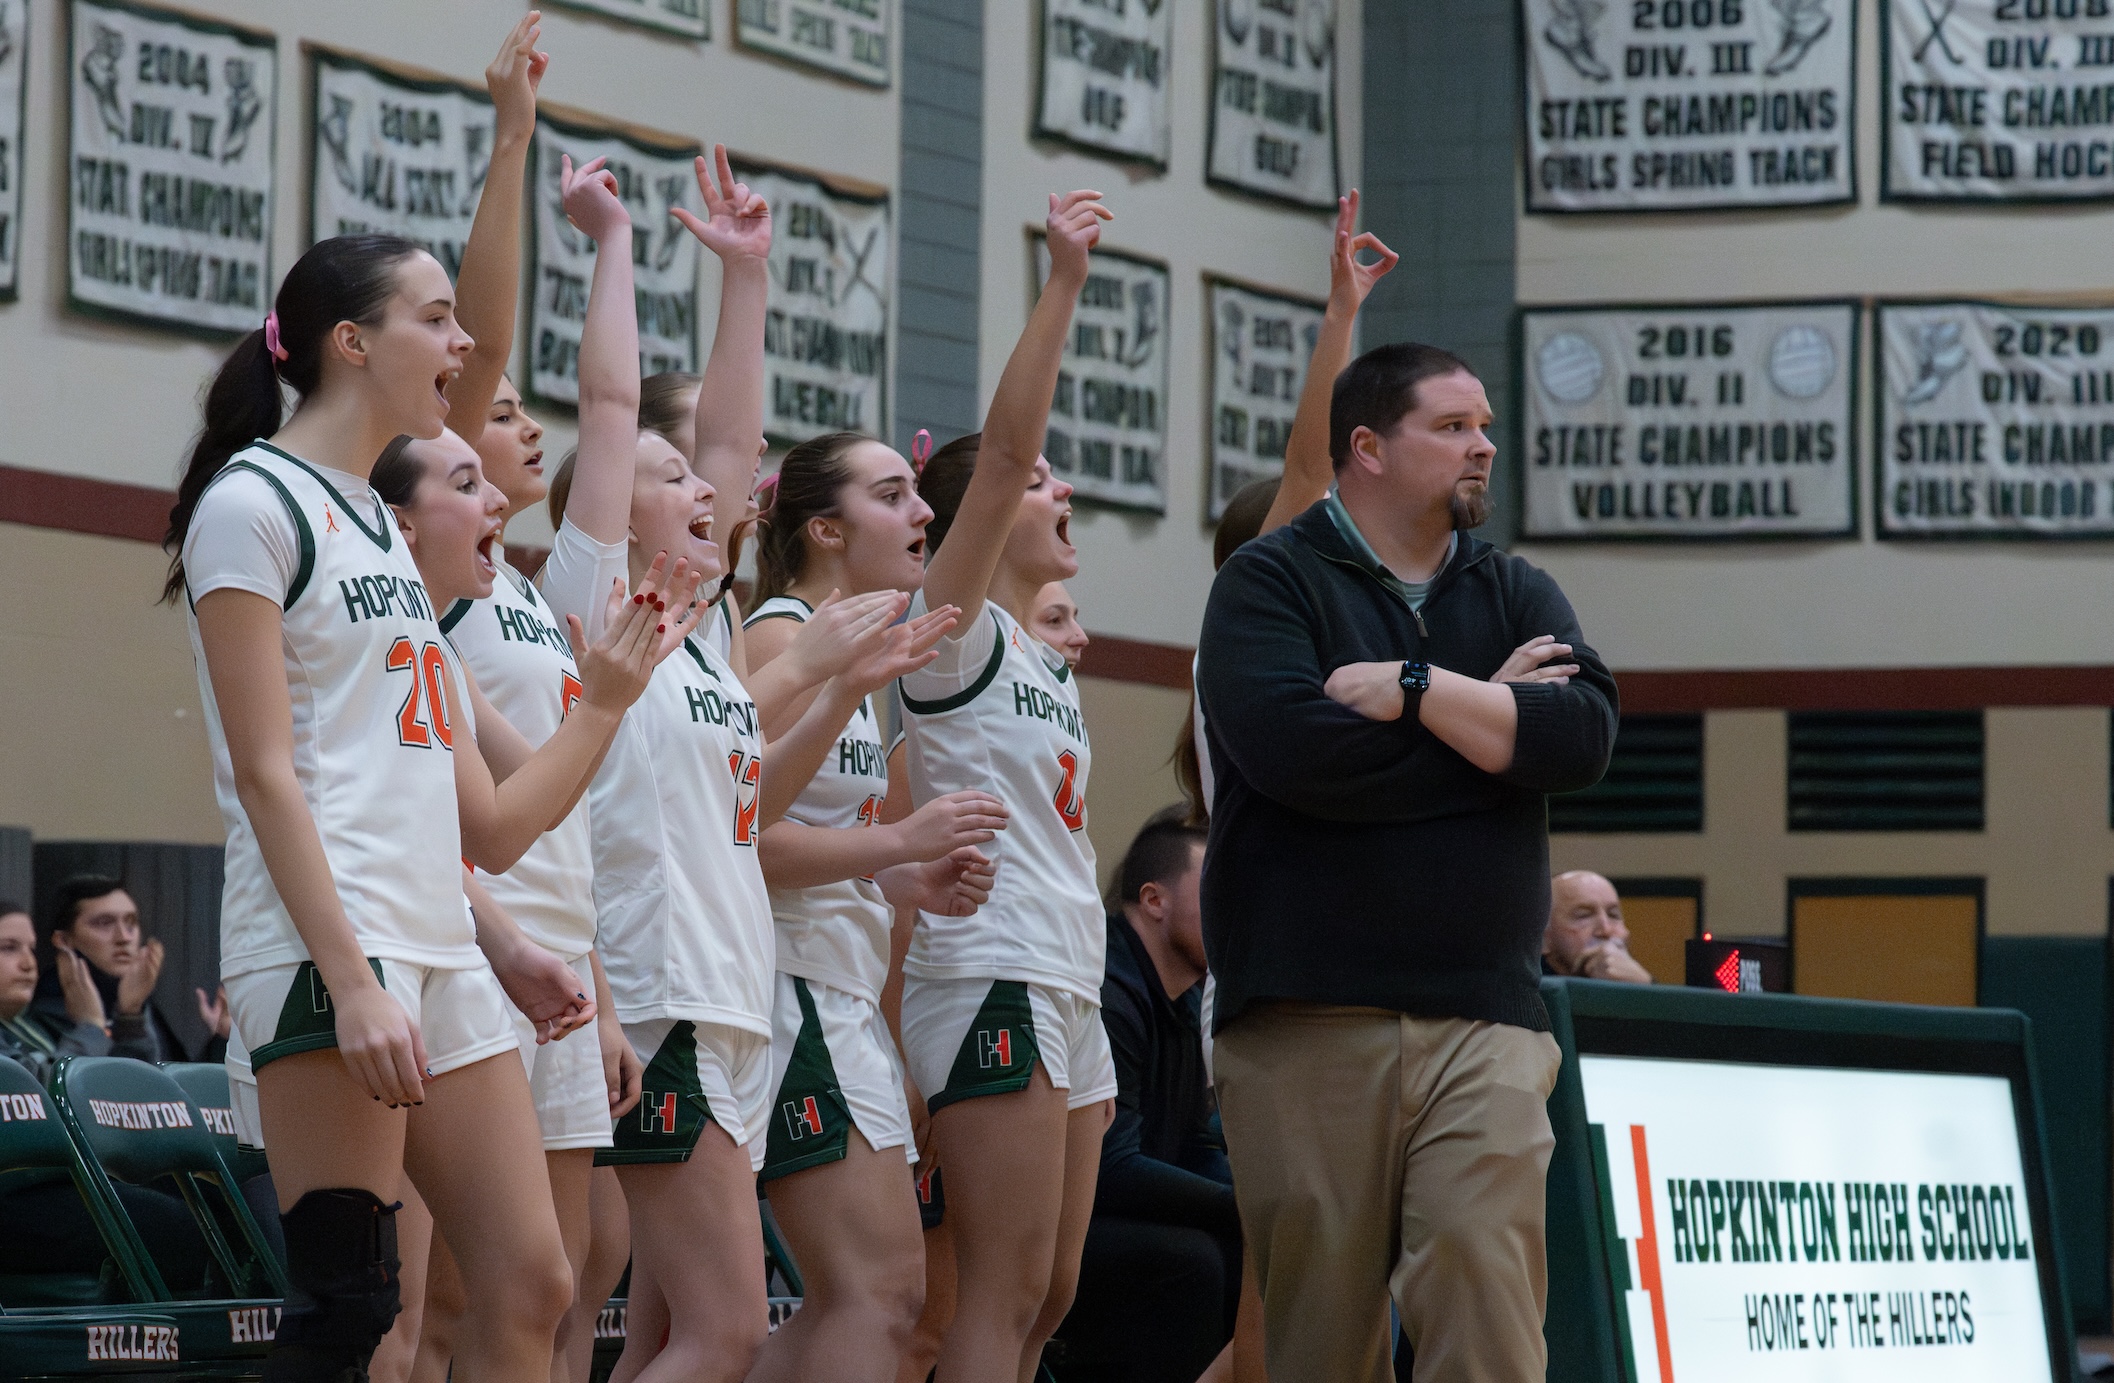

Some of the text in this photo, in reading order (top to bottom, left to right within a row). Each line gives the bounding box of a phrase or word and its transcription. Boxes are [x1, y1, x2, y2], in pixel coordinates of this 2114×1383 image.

[1634, 0, 1743, 29] 2006
[1626, 41, 1753, 78] DIV. III
[1987, 36, 2059, 69] DIV.
[1540, 90, 1836, 139] STATE CHAMPIONS
[1901, 81, 1986, 126] STATE
[1541, 145, 1839, 190] GIRLS SPRING TRACK
[1922, 142, 2114, 178] FIELD HOC
[1638, 324, 1733, 359] 2016
[1995, 325, 2099, 355] 2020
[1628, 372, 1744, 407] DIV. II
[1983, 371, 2054, 403] DIV.
[1536, 421, 1836, 467] STATE CHAMPIONS
[1896, 423, 1985, 463] STATE
[1572, 479, 1797, 518] VOLLEYBALL
[1895, 478, 2095, 517] GIRLS INDOOR
[386, 635, 453, 751] 20
[89, 1099, 193, 1130] HOPKINTON
[1667, 1178, 2030, 1263] HOPKINTON HIGH SCHOOL
[1745, 1290, 1974, 1351] HOME OF THE HILLERS
[86, 1325, 179, 1361] HILLERS
